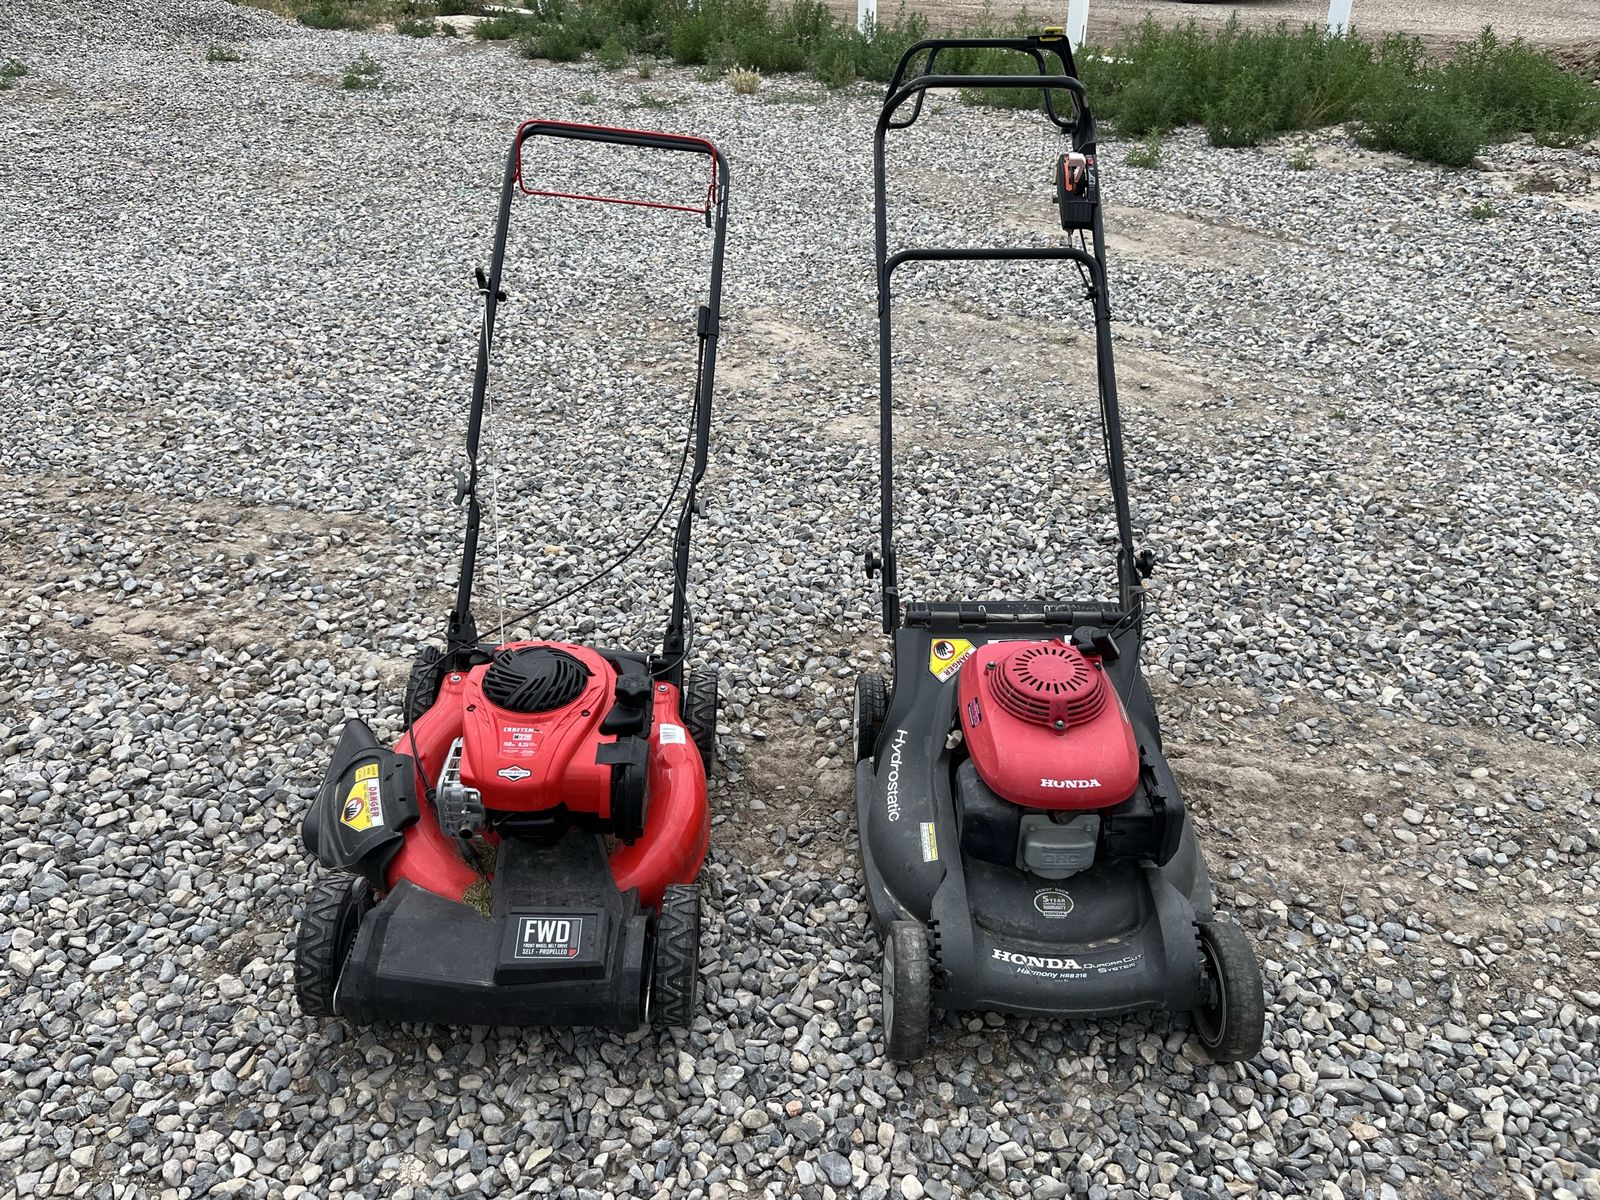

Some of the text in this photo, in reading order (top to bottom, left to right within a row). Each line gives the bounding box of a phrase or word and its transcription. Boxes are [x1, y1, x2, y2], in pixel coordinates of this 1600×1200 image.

[944, 652, 971, 676] DANGER
[887, 729, 908, 822] Hydrostatic
[1040, 779, 1102, 788] HONDA
[369, 786, 380, 818] DANGER
[1043, 854, 1080, 864] OHC
[1042, 895, 1050, 903] 5
[523, 920, 571, 943] FWD
[991, 948, 1082, 970] HONDA
[1016, 966, 1058, 979] Harmony
